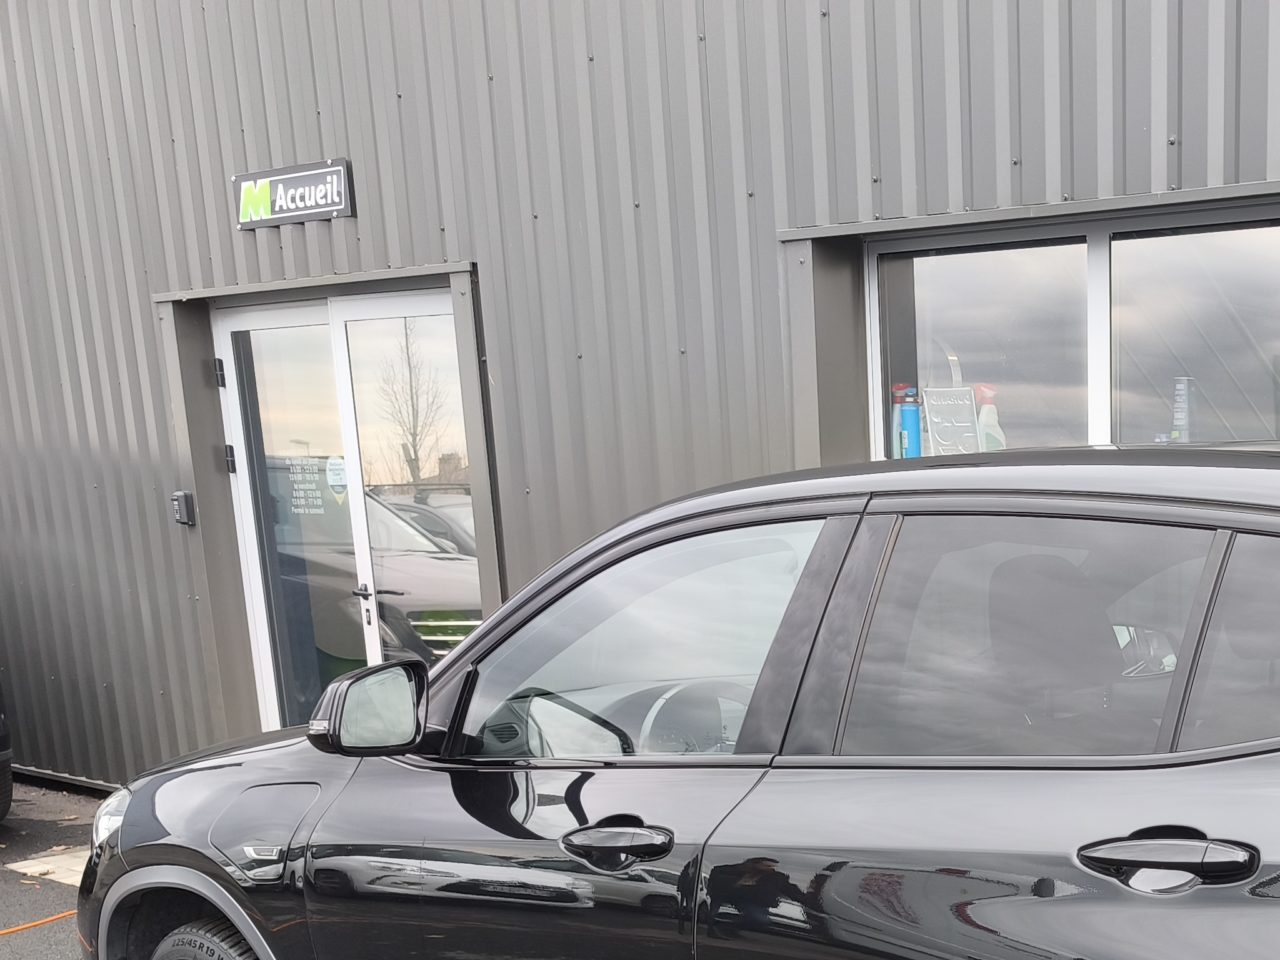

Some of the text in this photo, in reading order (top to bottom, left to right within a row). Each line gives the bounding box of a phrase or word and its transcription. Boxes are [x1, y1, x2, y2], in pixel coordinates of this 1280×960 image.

[274, 174, 340, 212] Accueil
[197, 942, 205, 953] R
[205, 946, 216, 958] 19
